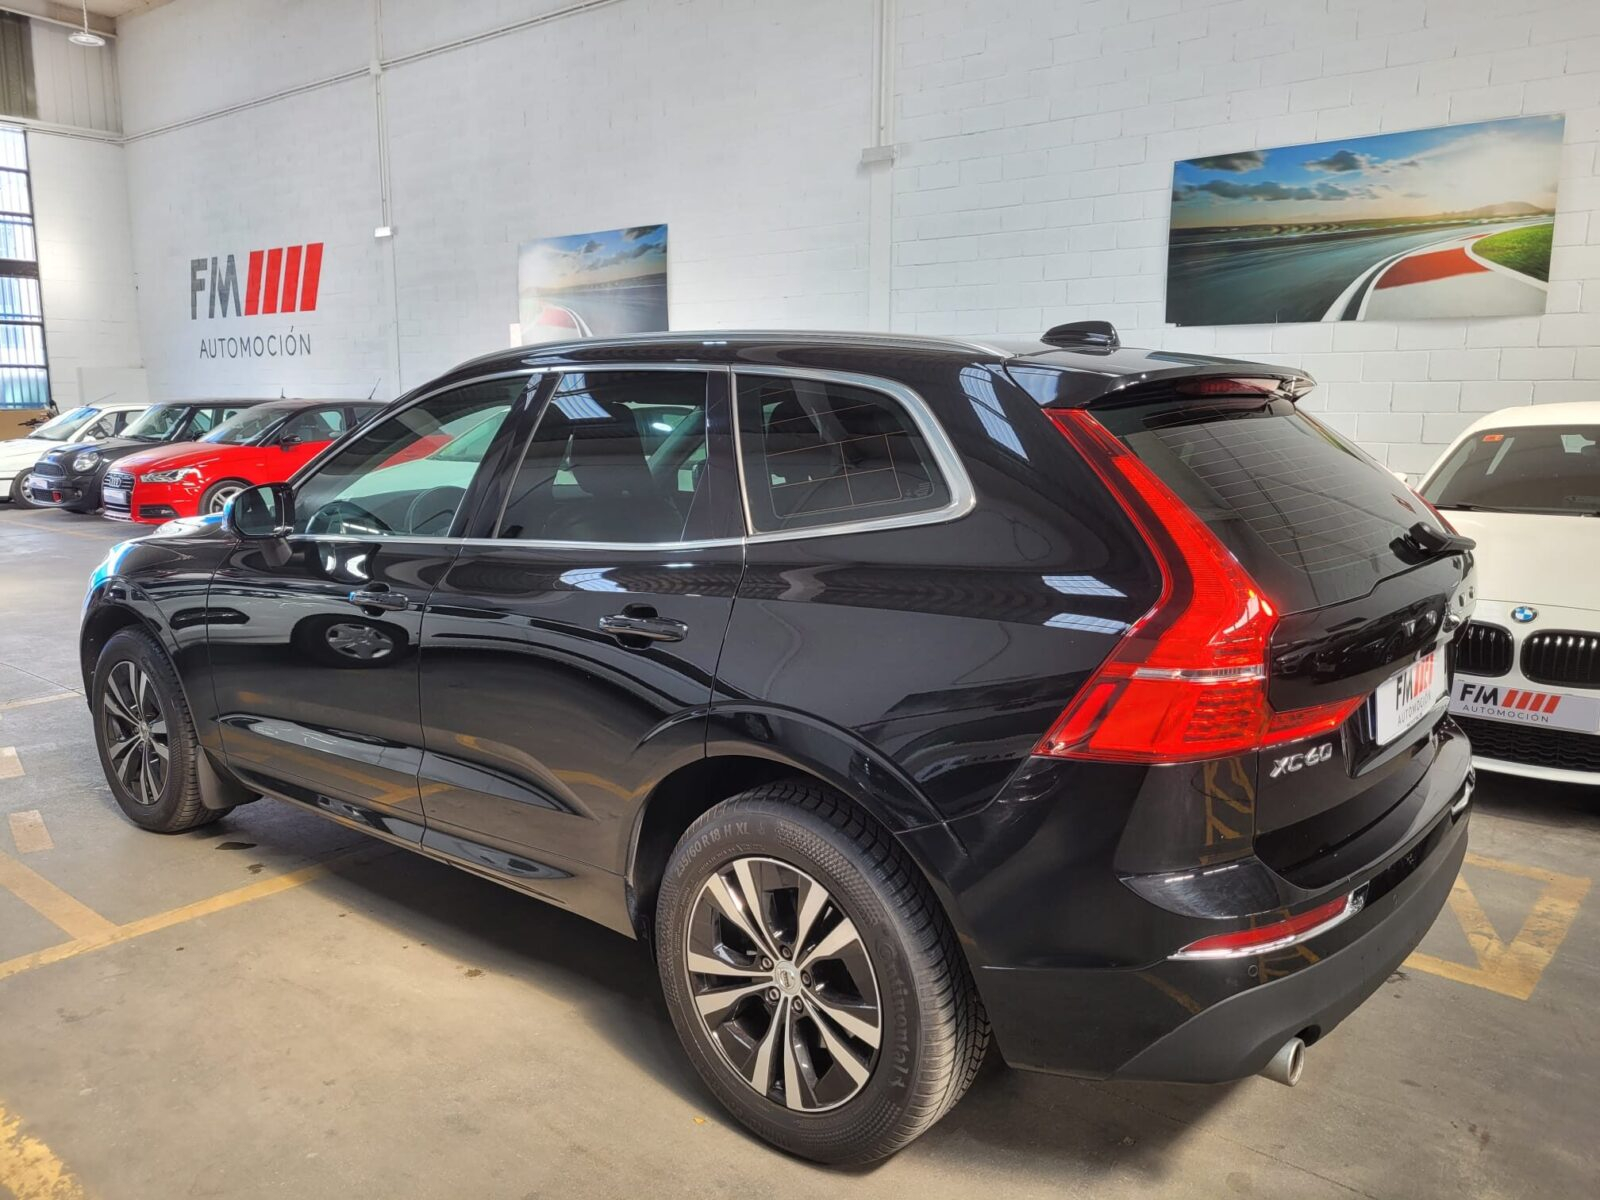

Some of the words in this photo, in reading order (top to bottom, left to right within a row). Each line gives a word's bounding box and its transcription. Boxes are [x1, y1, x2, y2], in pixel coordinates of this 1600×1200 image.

[191, 254, 242, 320] FM
[200, 325, 311, 359] AUTOMOCIÓN
[1460, 683, 1498, 706] FM
[1462, 704, 1549, 722] AUTOMOCIÓN
